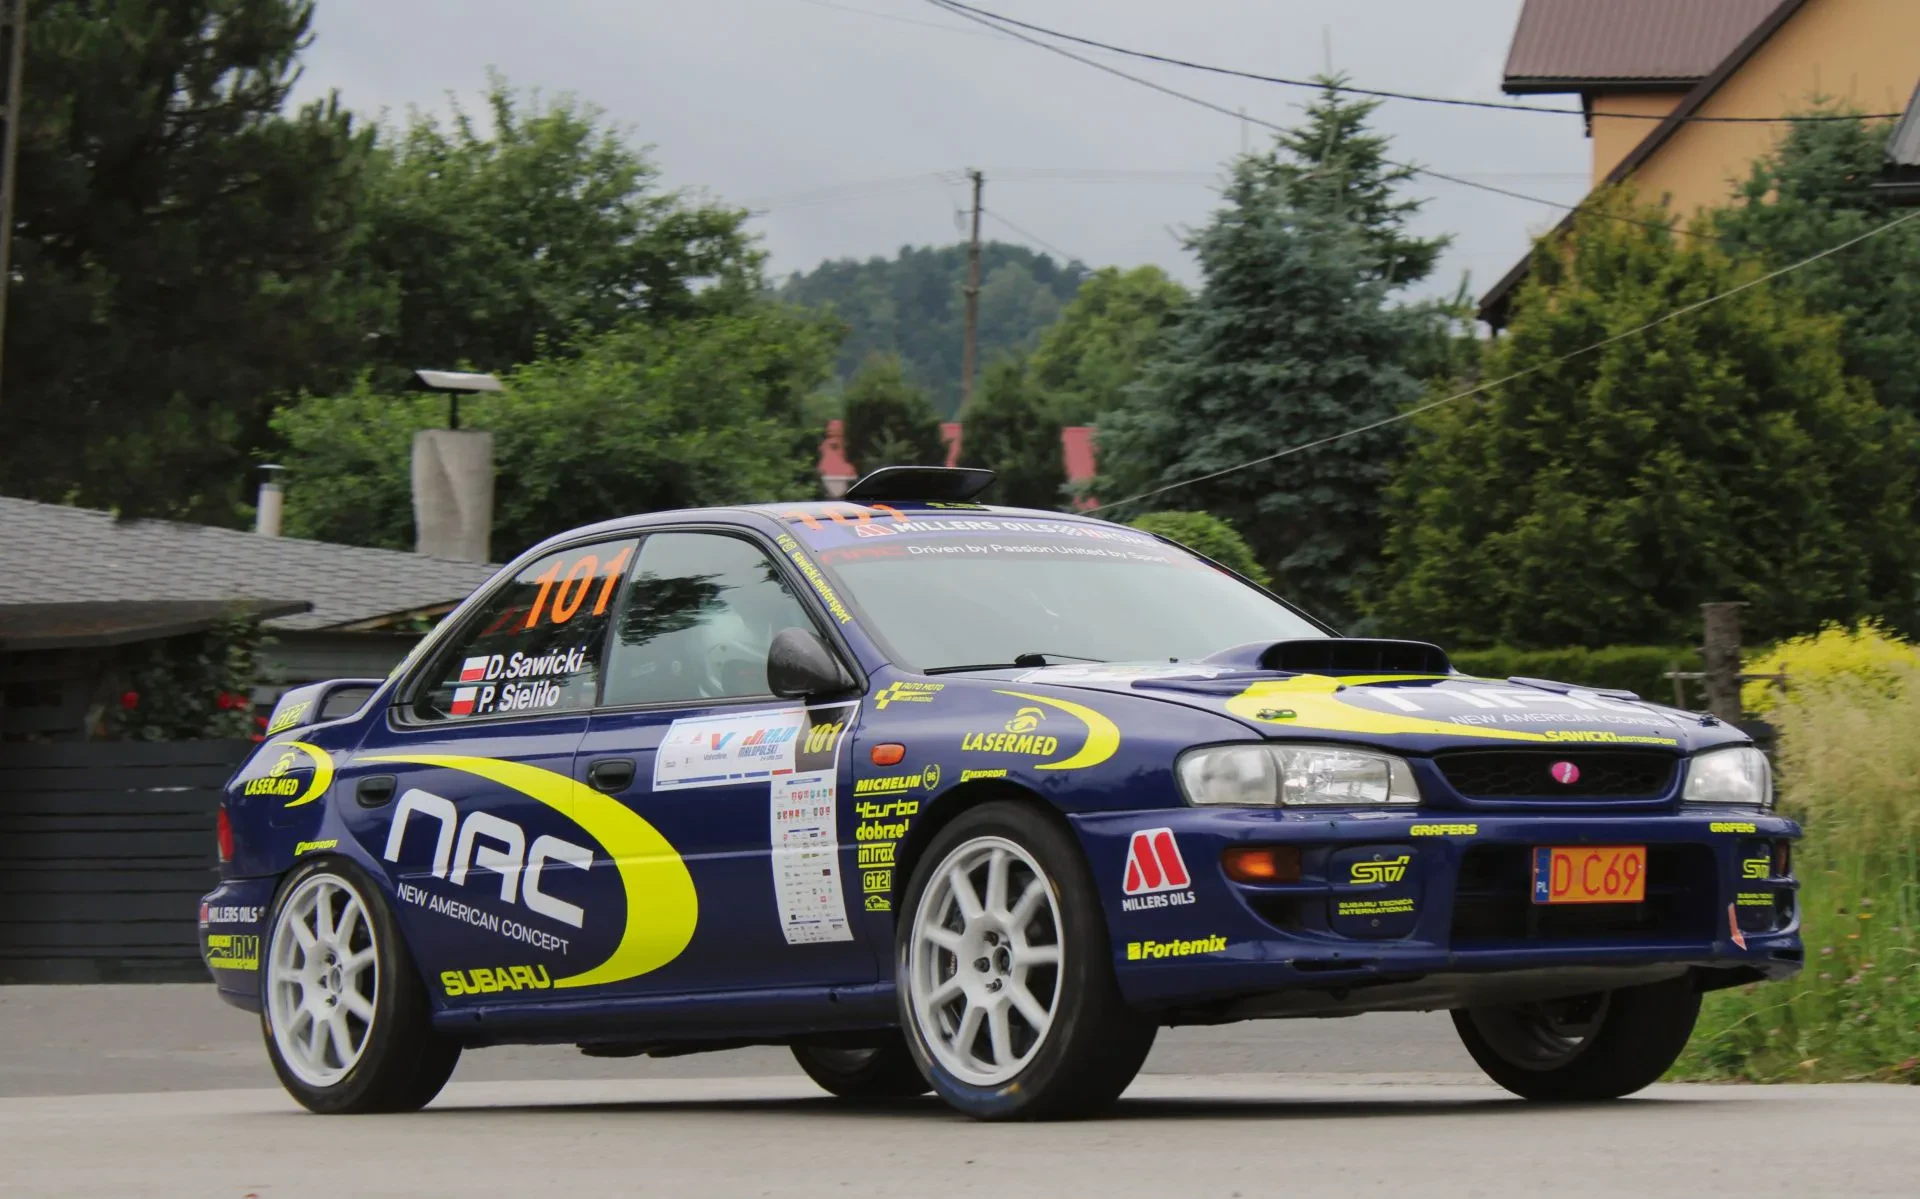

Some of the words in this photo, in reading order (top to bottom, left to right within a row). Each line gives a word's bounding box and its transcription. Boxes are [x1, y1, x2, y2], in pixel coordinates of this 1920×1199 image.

[893, 520, 1000, 533] MILLERS
[1001, 521, 1057, 534] OILS
[908, 546, 966, 554] Driven
[965, 544, 988, 554] by
[990, 544, 1053, 554] Passion
[1053, 545, 1107, 557] United
[525, 548, 632, 629] 101
[791, 551, 854, 624] sawicki.motorsport
[485, 646, 587, 681] D.Sawicki
[477, 686, 494, 713] P.
[1450, 715, 1498, 726] NEW
[1503, 713, 1602, 724] AMERICAN
[804, 722, 844, 754] 101
[961, 732, 1058, 756] LASERMED
[1544, 730, 1618, 743] SAWICKI
[855, 775, 922, 792] MICHELIN
[855, 799, 920, 819] 4turbo
[1410, 824, 1479, 836] GRAFERS
[1535, 881, 1549, 893] PL
[1122, 894, 1169, 912] MILLERS
[1169, 891, 1196, 906] OILS
[1338, 901, 1378, 909] SUBARU
[1338, 905, 1415, 916] INTERNATIONAL
[208, 906, 239, 923] MILLERS
[240, 906, 259, 923] OILS
[397, 882, 428, 906] NEW
[429, 895, 499, 933] AMERICAN
[502, 919, 569, 955] CONCEPT
[1142, 934, 1228, 960] Fortemix
[440, 963, 551, 997] SUBARU
